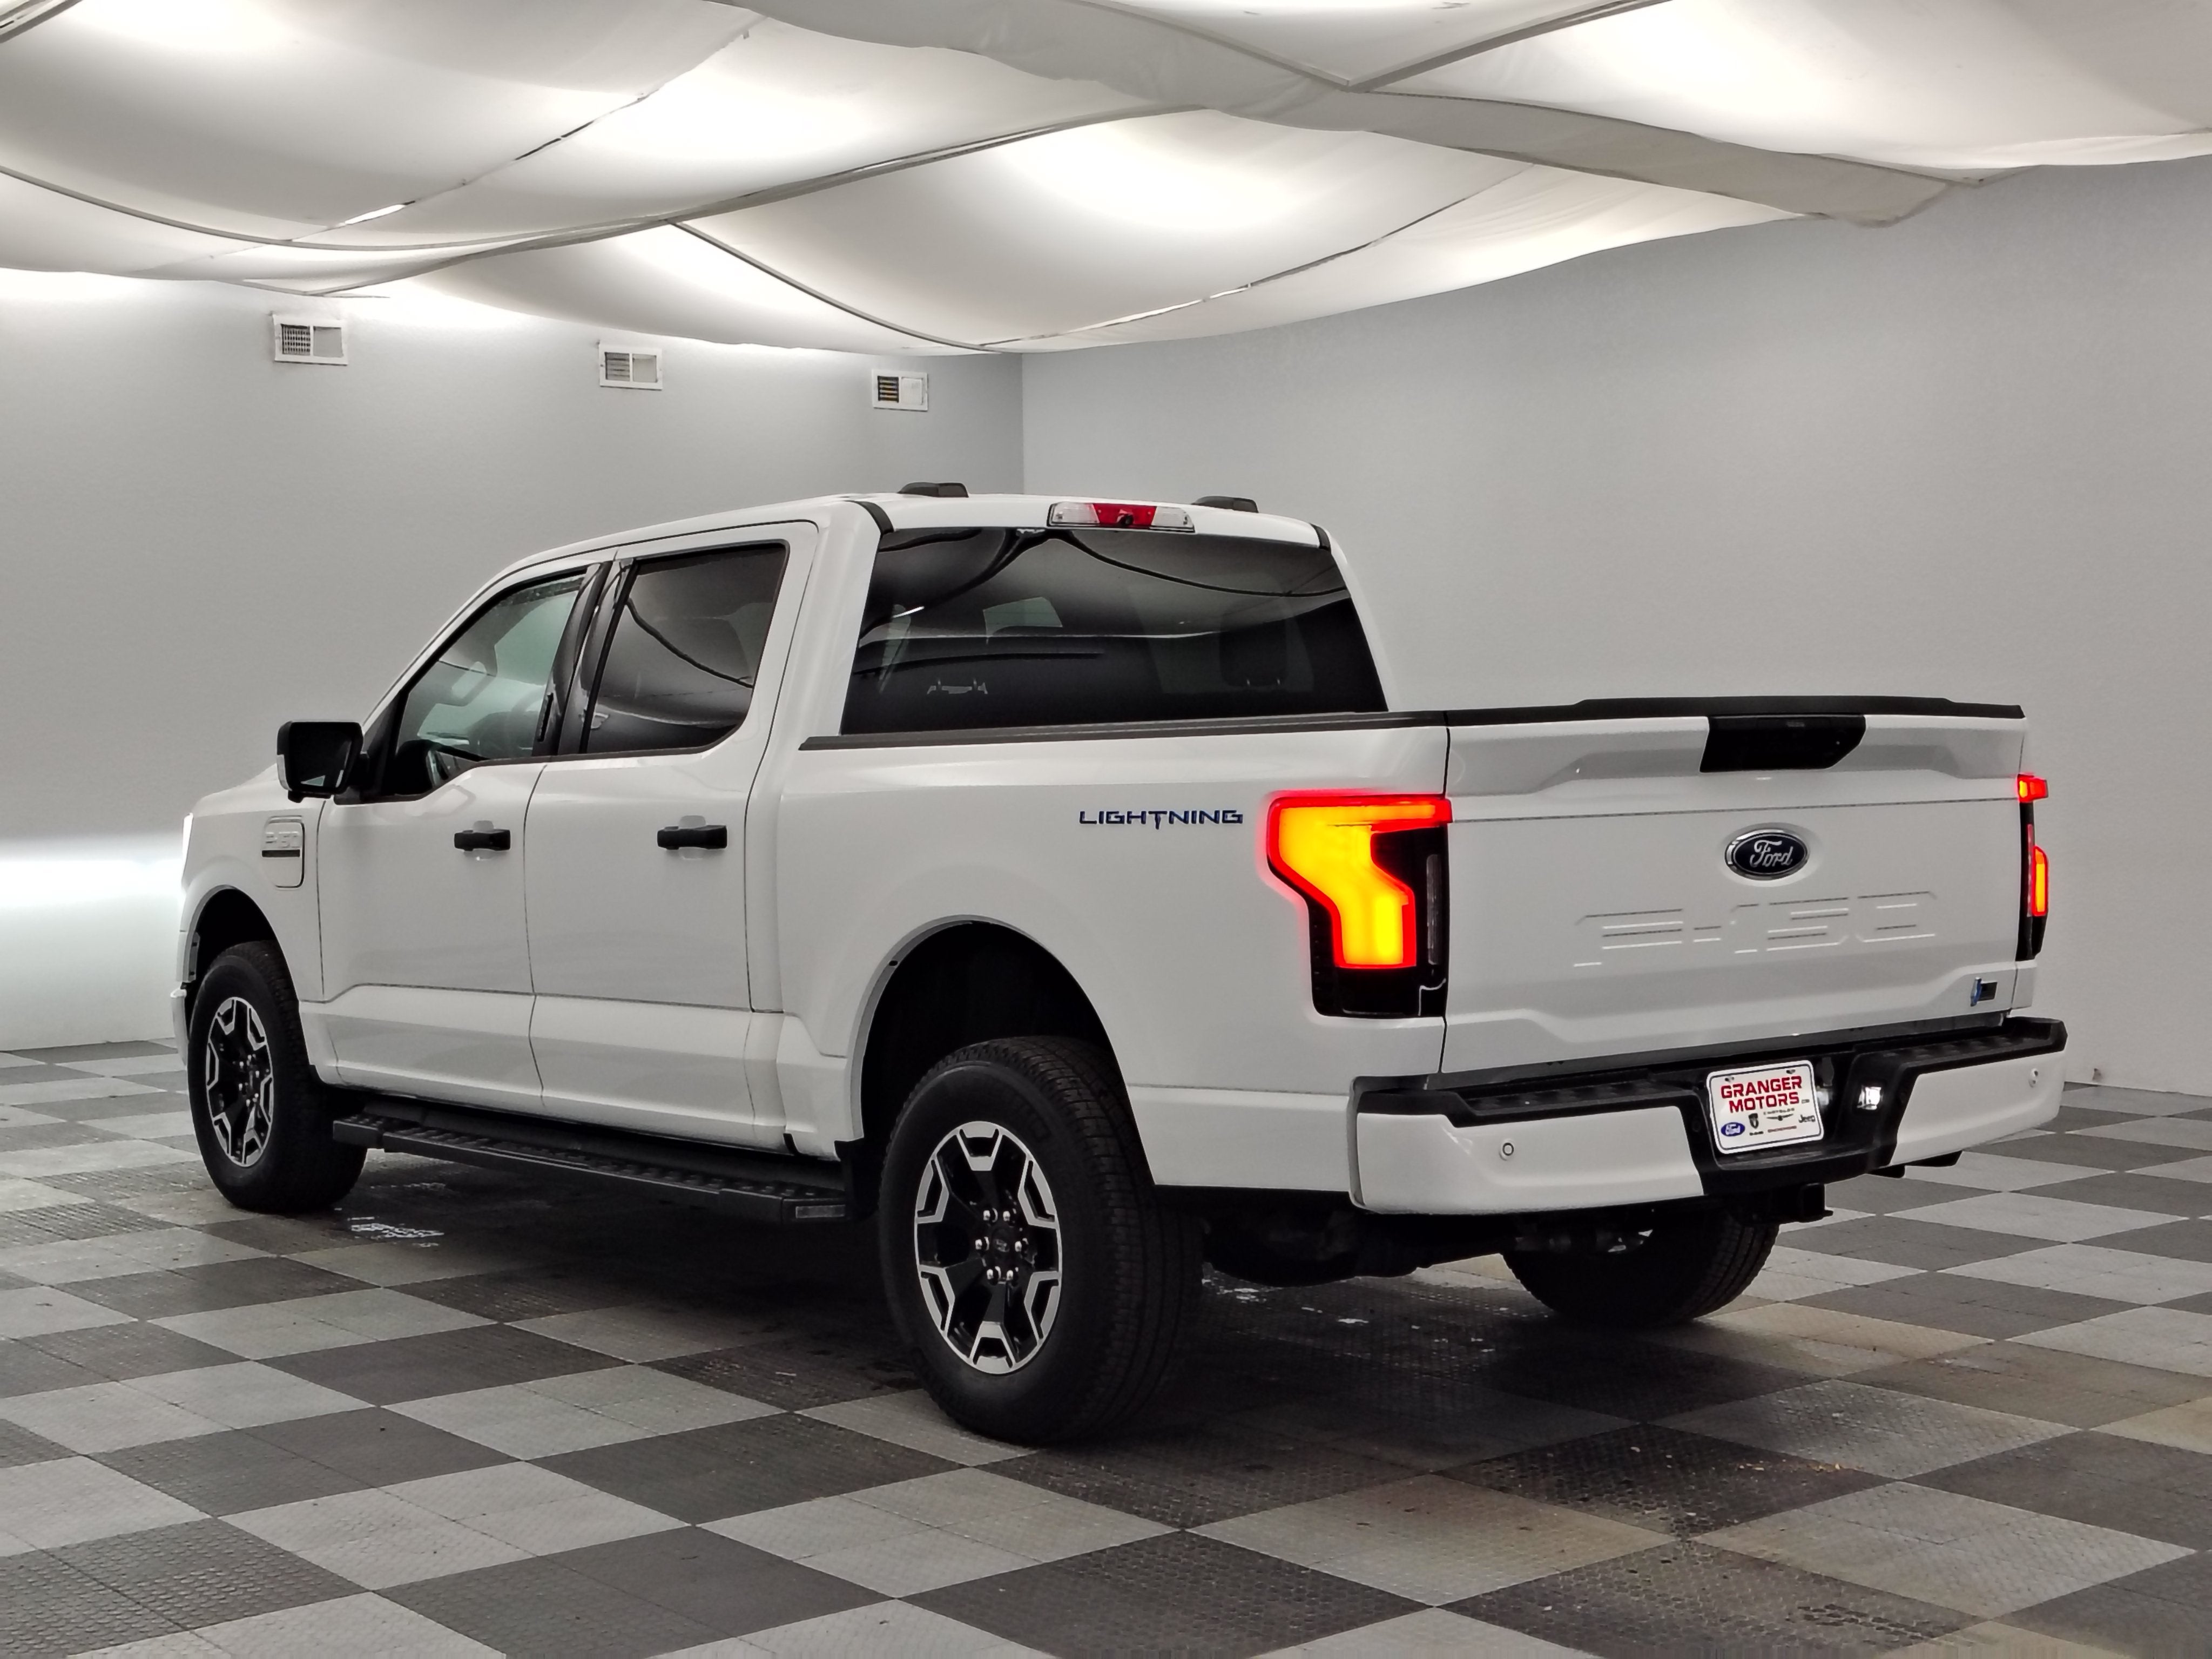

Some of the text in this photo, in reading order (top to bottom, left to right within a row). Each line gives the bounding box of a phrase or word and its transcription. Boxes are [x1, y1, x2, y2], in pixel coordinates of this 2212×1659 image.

[1080, 810, 1243, 830] LIGHTNING
[1750, 840, 1793, 867] Ford
[1574, 891, 1938, 967] F-150
[1721, 1076, 1802, 1099] GRANGER
[1729, 1091, 1799, 1114] MOTORS
